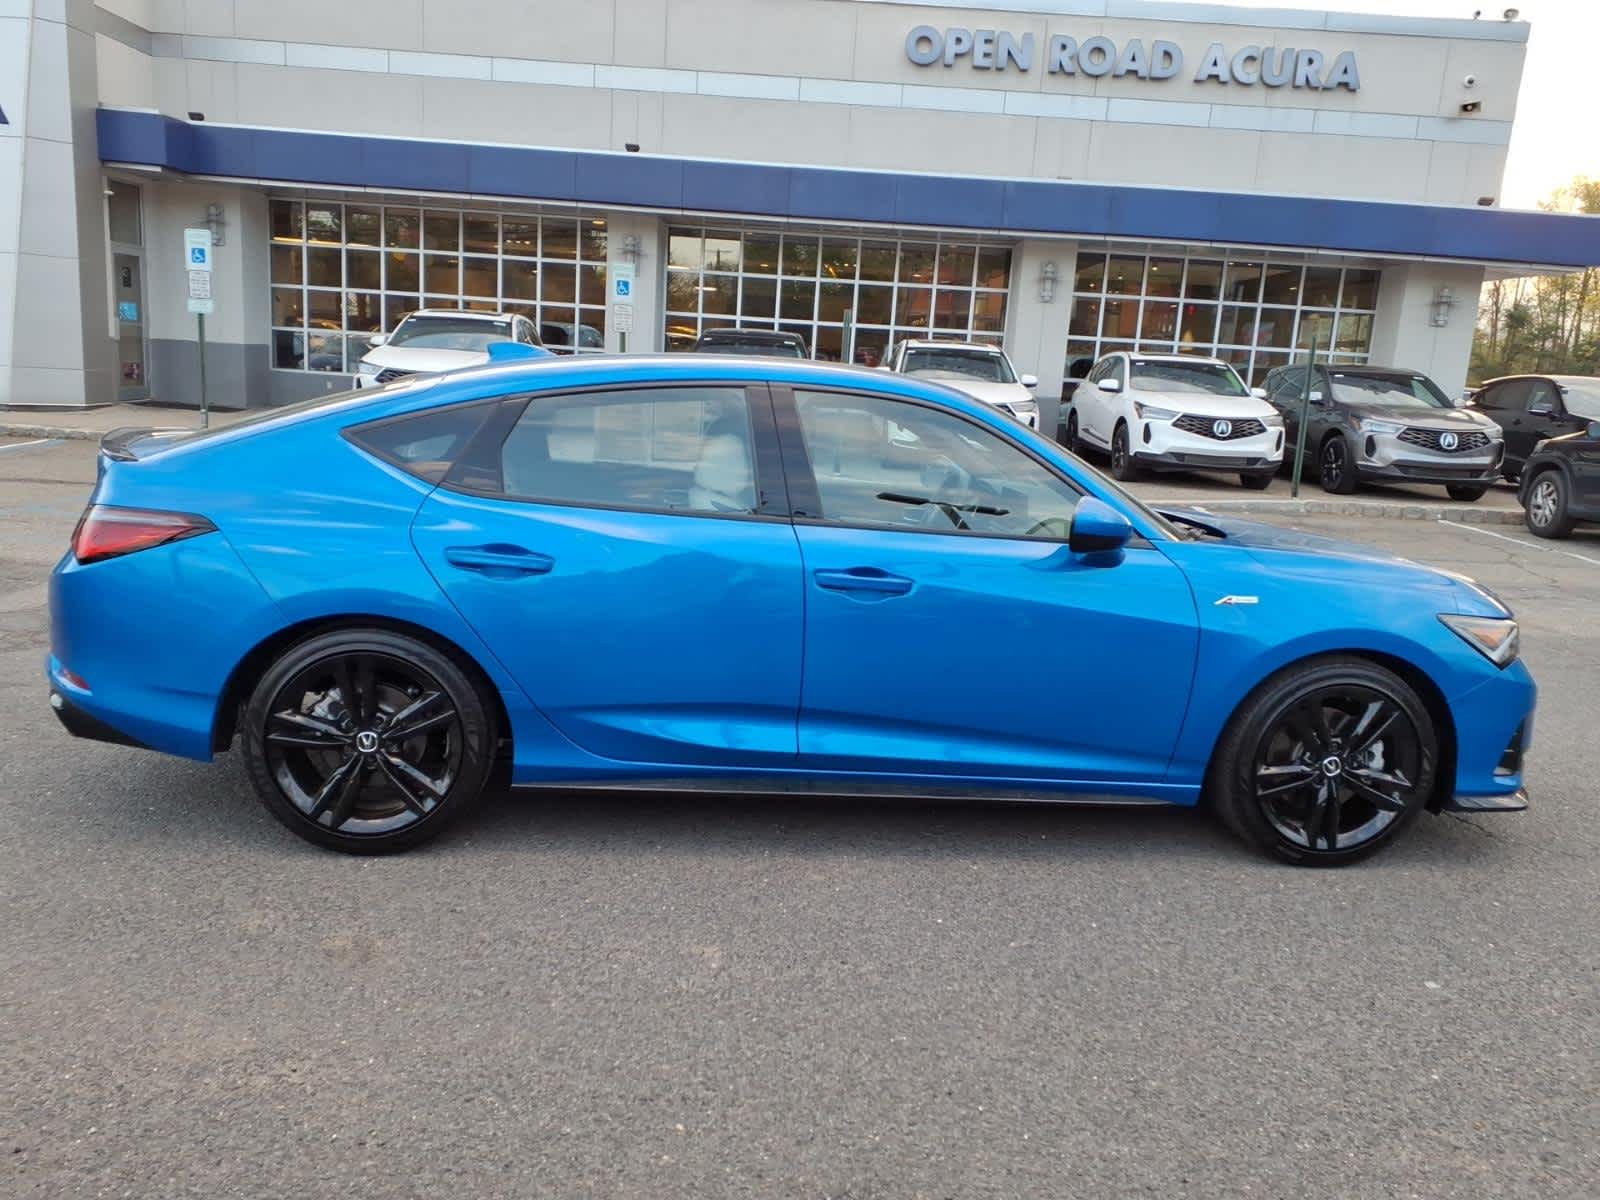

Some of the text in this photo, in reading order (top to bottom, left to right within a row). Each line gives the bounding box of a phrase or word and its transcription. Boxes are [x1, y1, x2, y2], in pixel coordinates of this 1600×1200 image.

[905, 25, 1360, 92] OPEN ROAD ACURA
